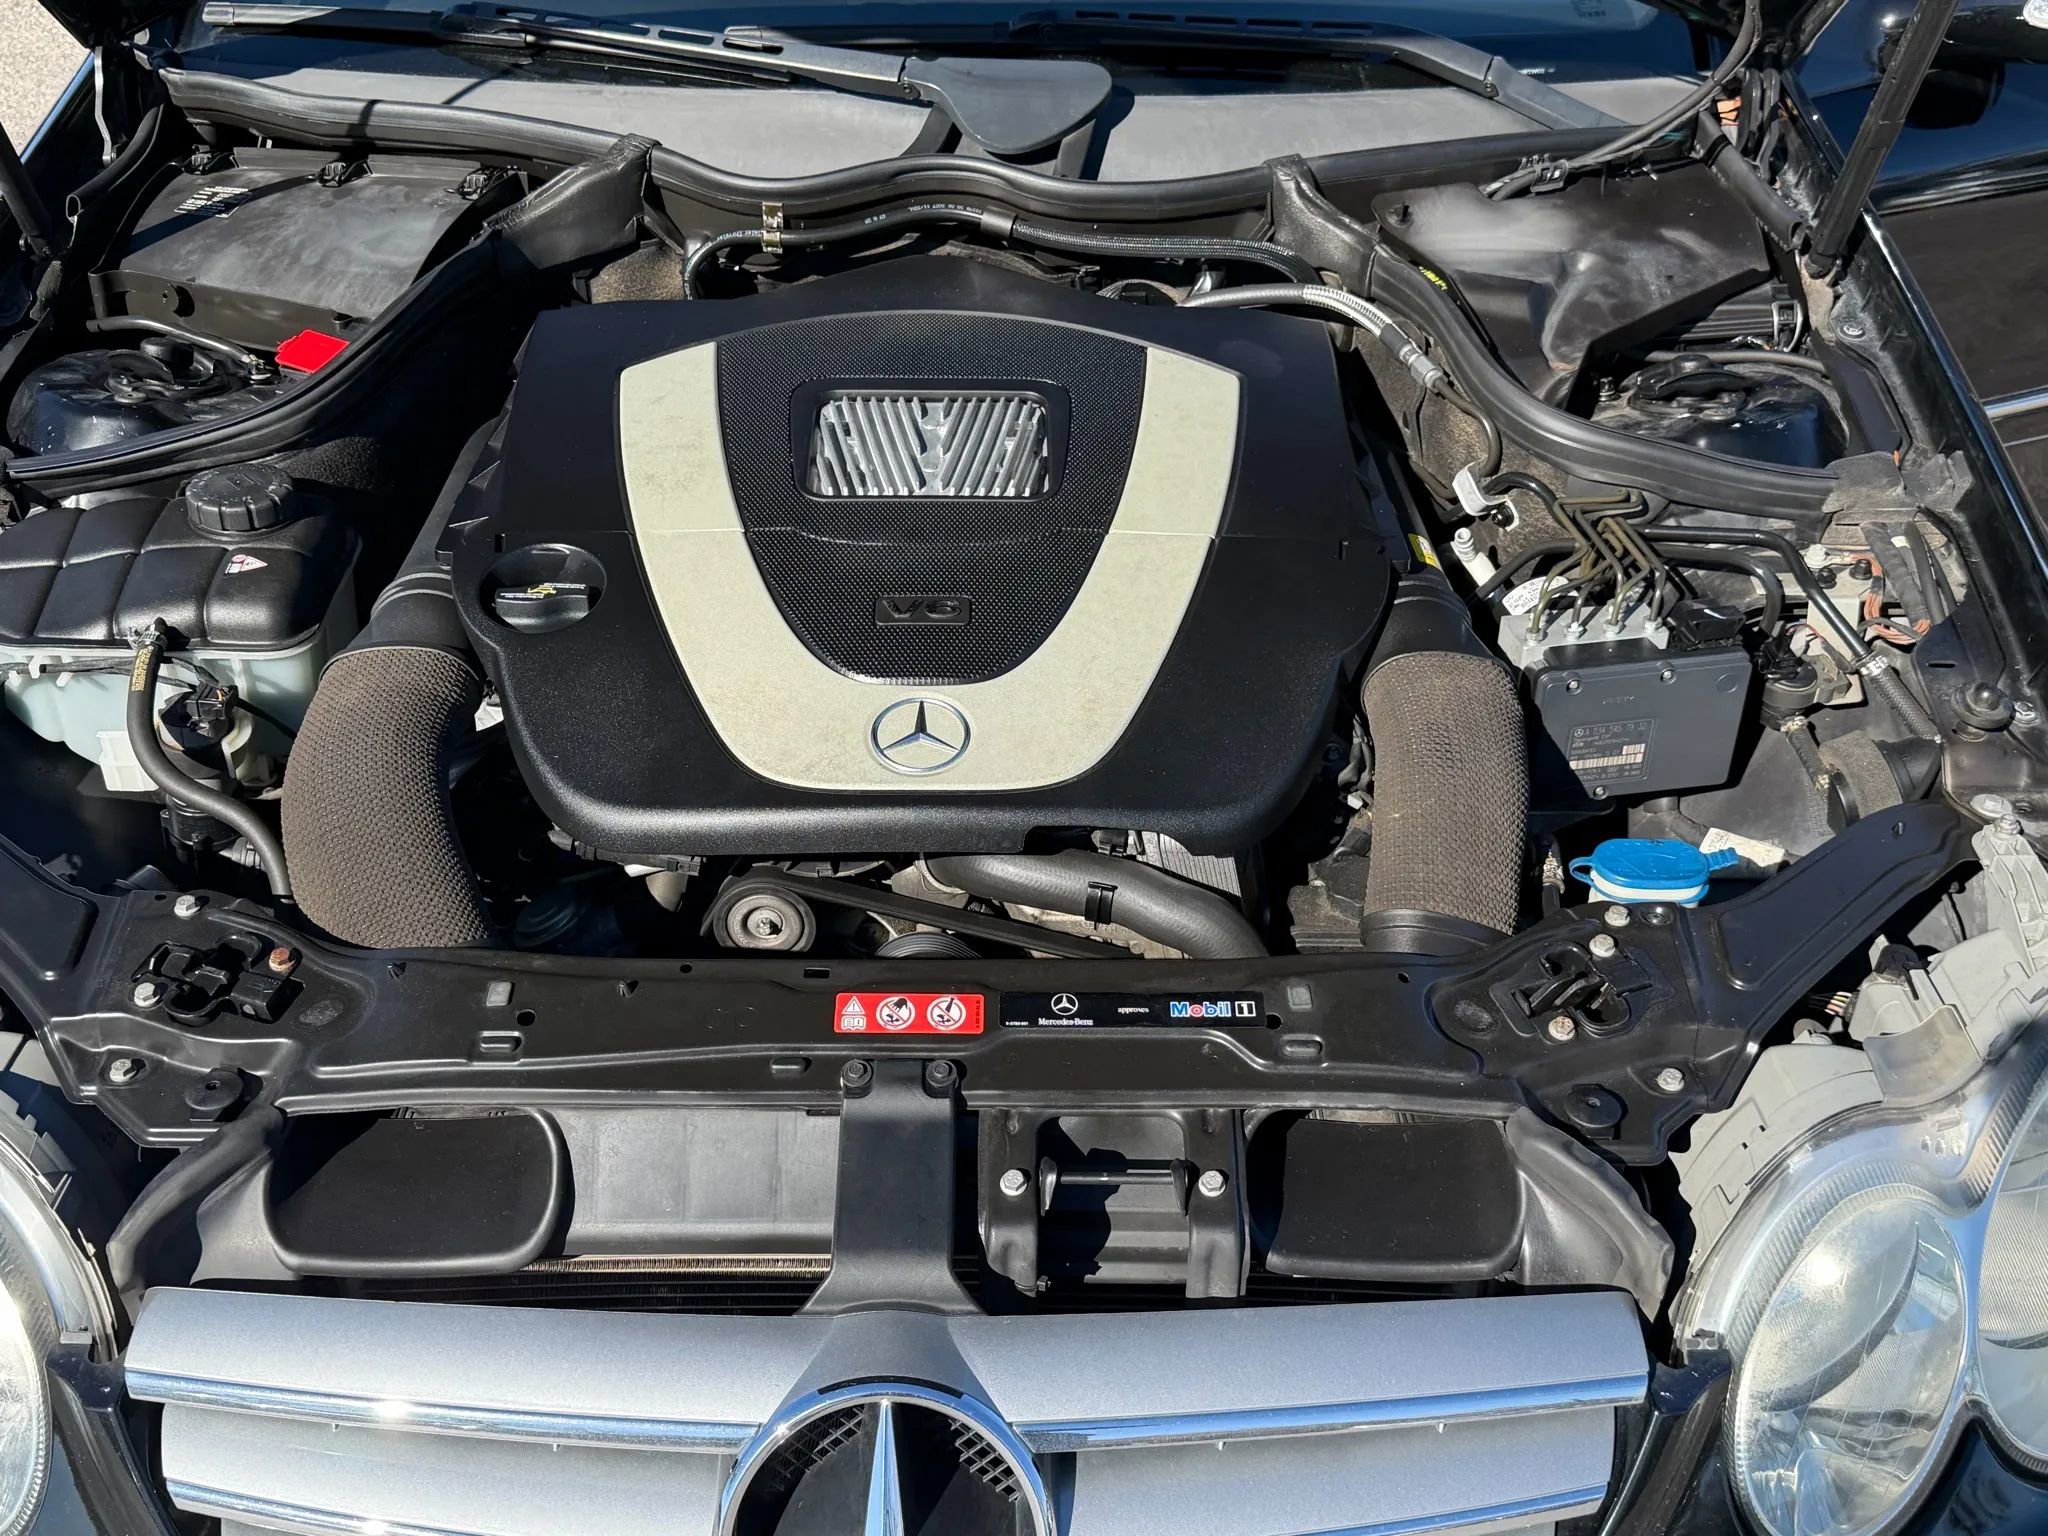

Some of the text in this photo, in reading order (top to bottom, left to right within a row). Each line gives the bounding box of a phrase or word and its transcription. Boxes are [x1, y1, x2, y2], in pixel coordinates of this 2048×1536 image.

[881, 599, 961, 619] V6
[1169, 1001, 1232, 1017] Mobil
[1038, 1017, 1094, 1026] Mercedes-Benz
